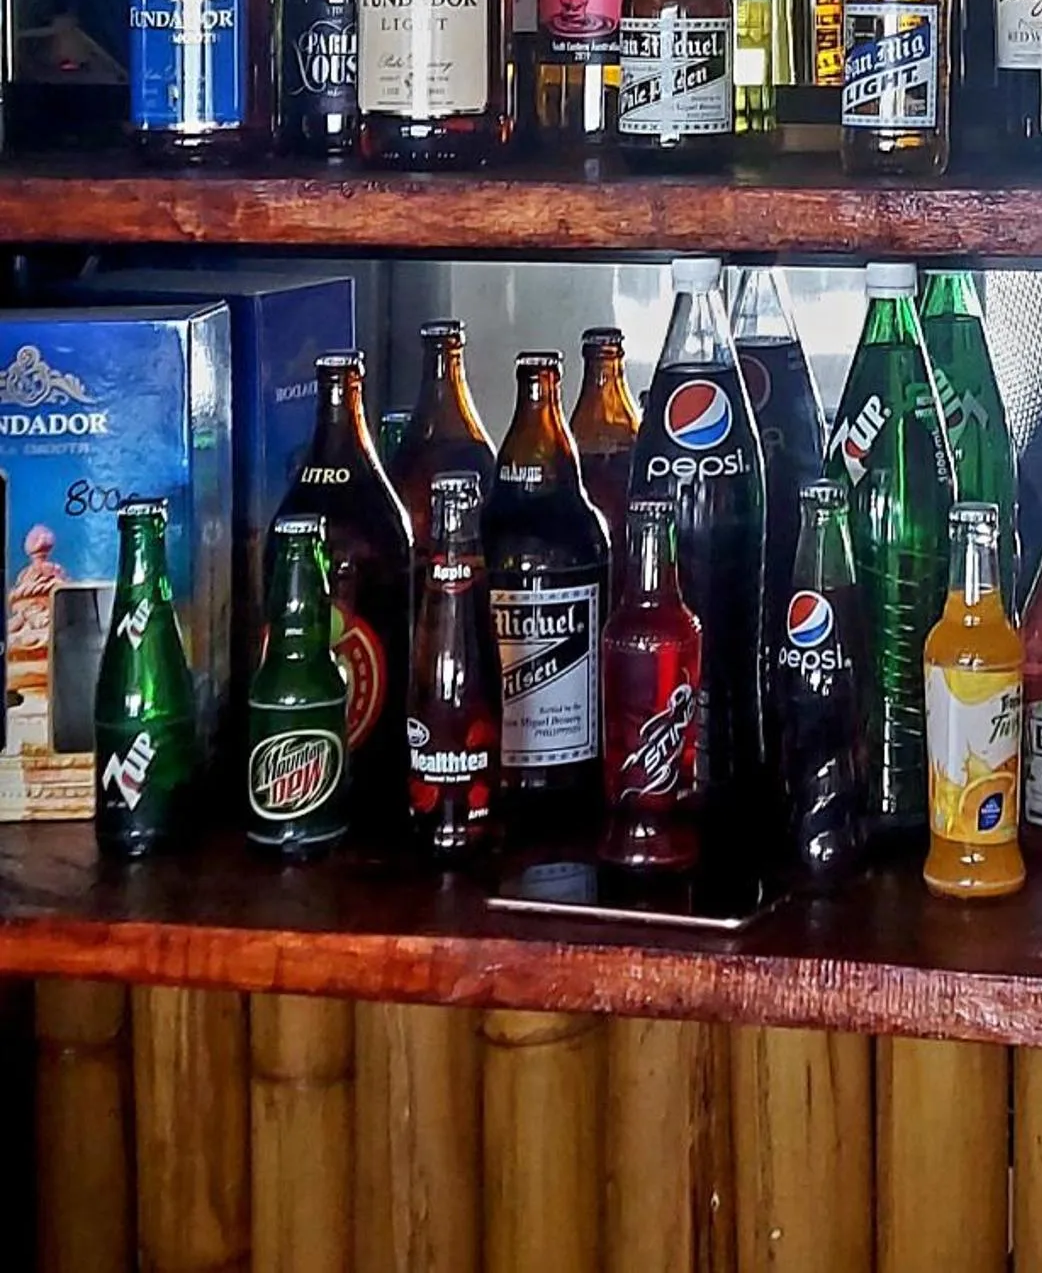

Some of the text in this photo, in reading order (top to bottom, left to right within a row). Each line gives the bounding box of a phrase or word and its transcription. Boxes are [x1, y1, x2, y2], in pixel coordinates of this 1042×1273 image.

[129, 6, 236, 30] FUNDAOR
[380, 17, 449, 31] LIGT
[874, 31, 926, 71] Mig
[300, 466, 351, 484] LITRO
[647, 448, 744, 483] pepsi
[432, 564, 472, 581] Apple
